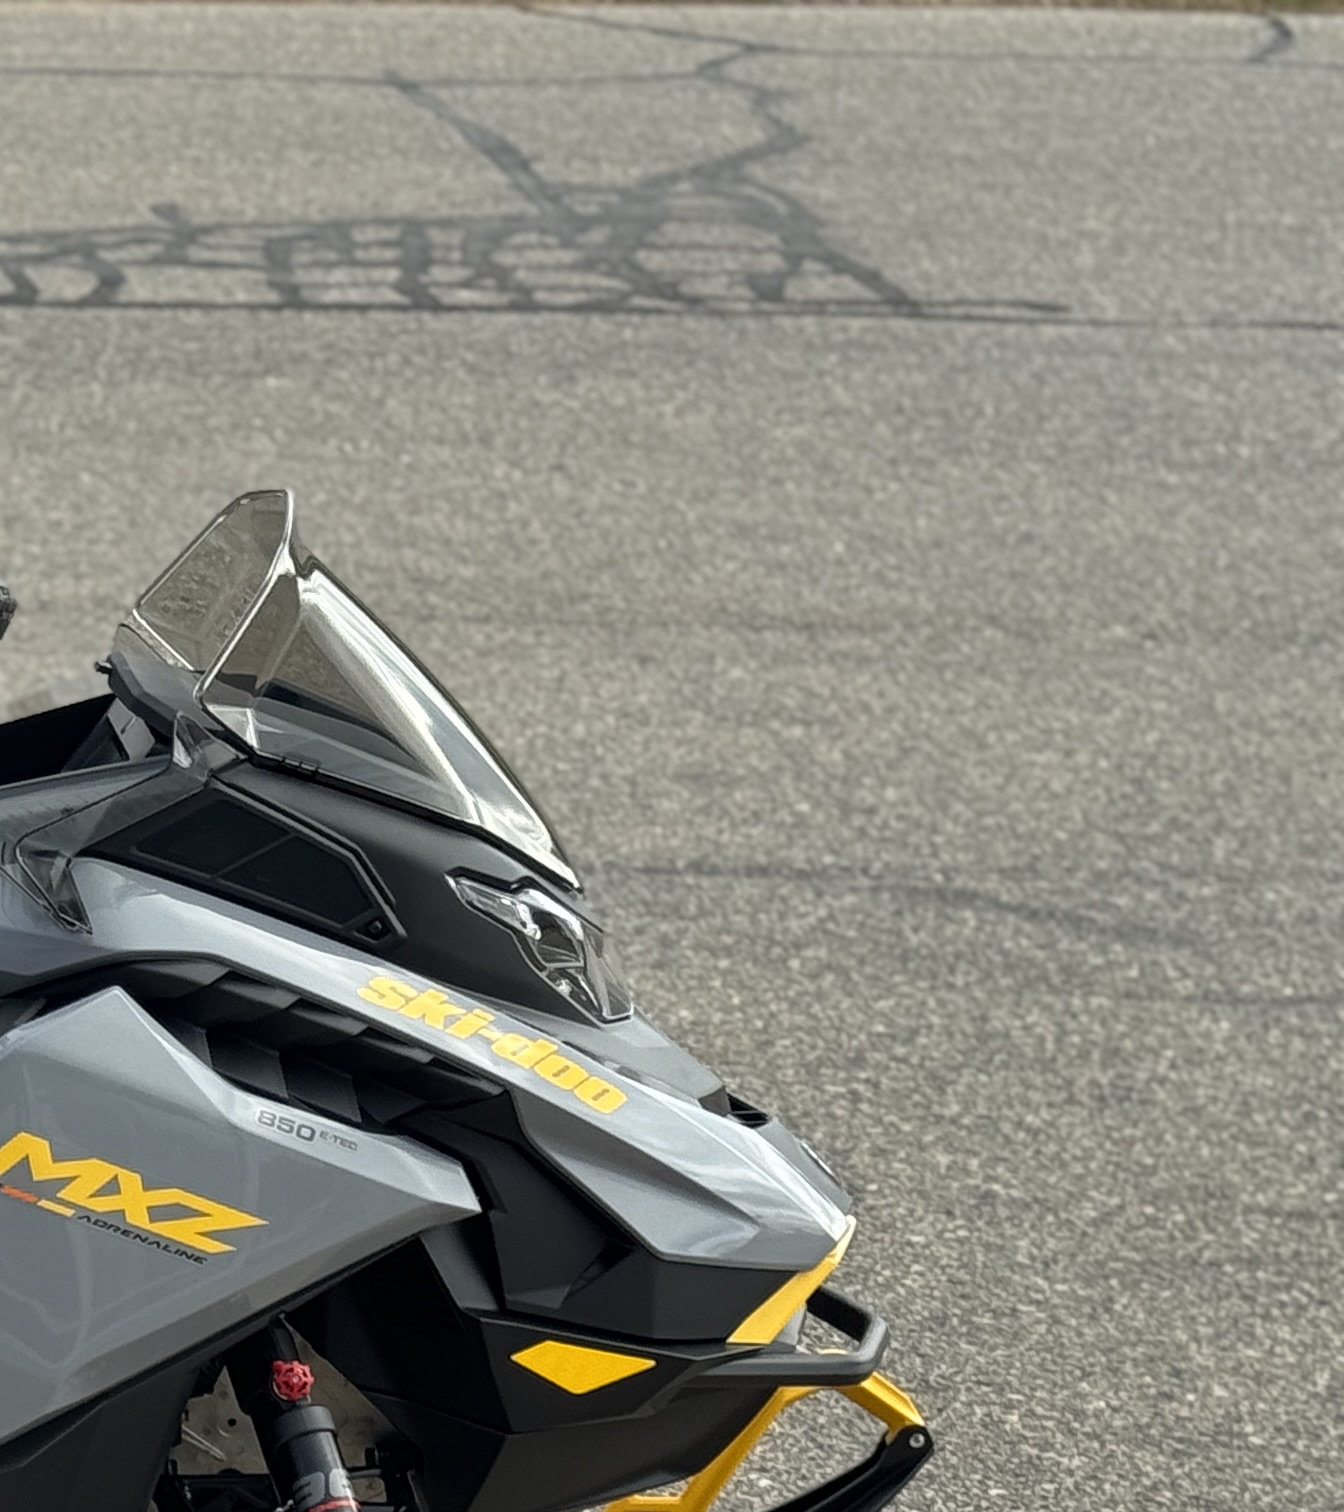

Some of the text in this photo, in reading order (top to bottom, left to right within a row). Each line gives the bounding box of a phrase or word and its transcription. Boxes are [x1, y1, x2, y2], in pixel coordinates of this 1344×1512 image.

[357, 976, 628, 1114] ski-doo
[257, 1109, 358, 1151] 850 E-TEC
[76, 1213, 208, 1265] ADRENALINE
